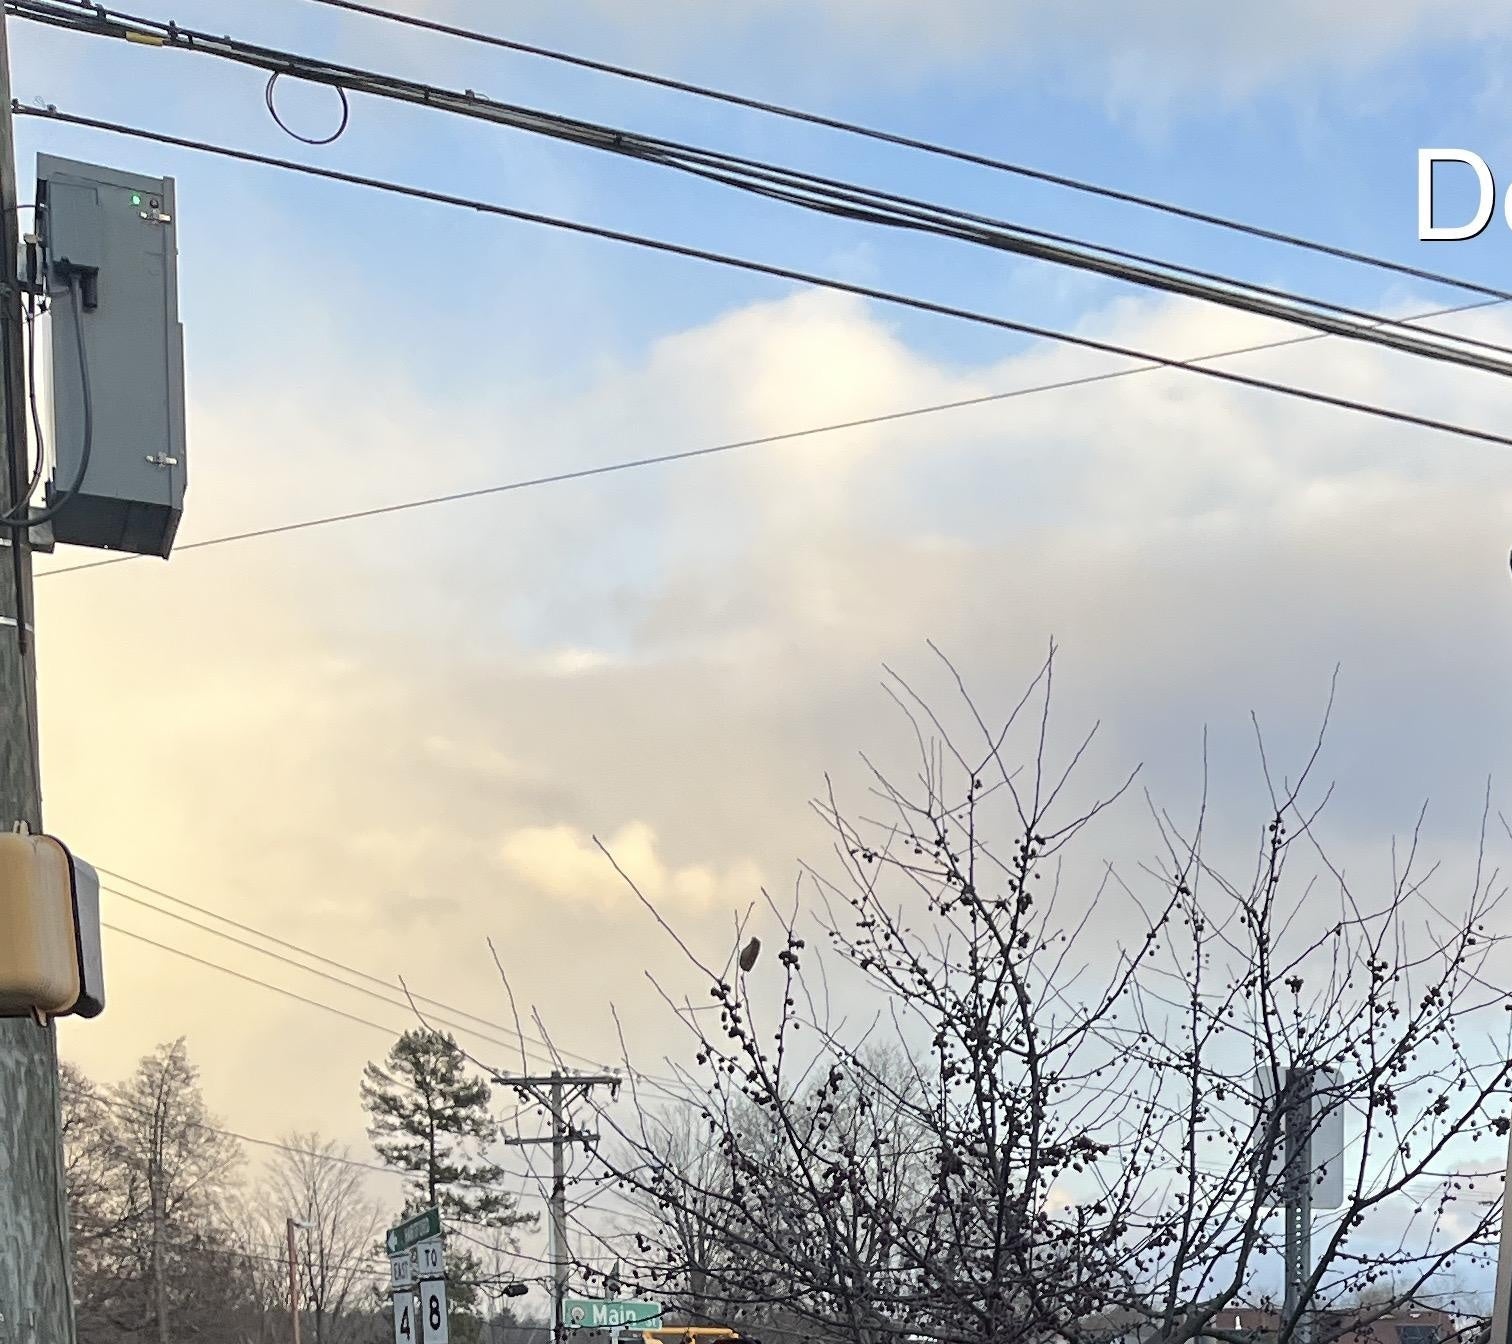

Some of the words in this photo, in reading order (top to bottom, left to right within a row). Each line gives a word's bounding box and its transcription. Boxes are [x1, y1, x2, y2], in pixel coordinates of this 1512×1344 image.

[424, 1248, 437, 1267] TO
[400, 1305, 411, 1341] 4
[429, 1294, 441, 1331] 8
[592, 1303, 637, 1326] Main
